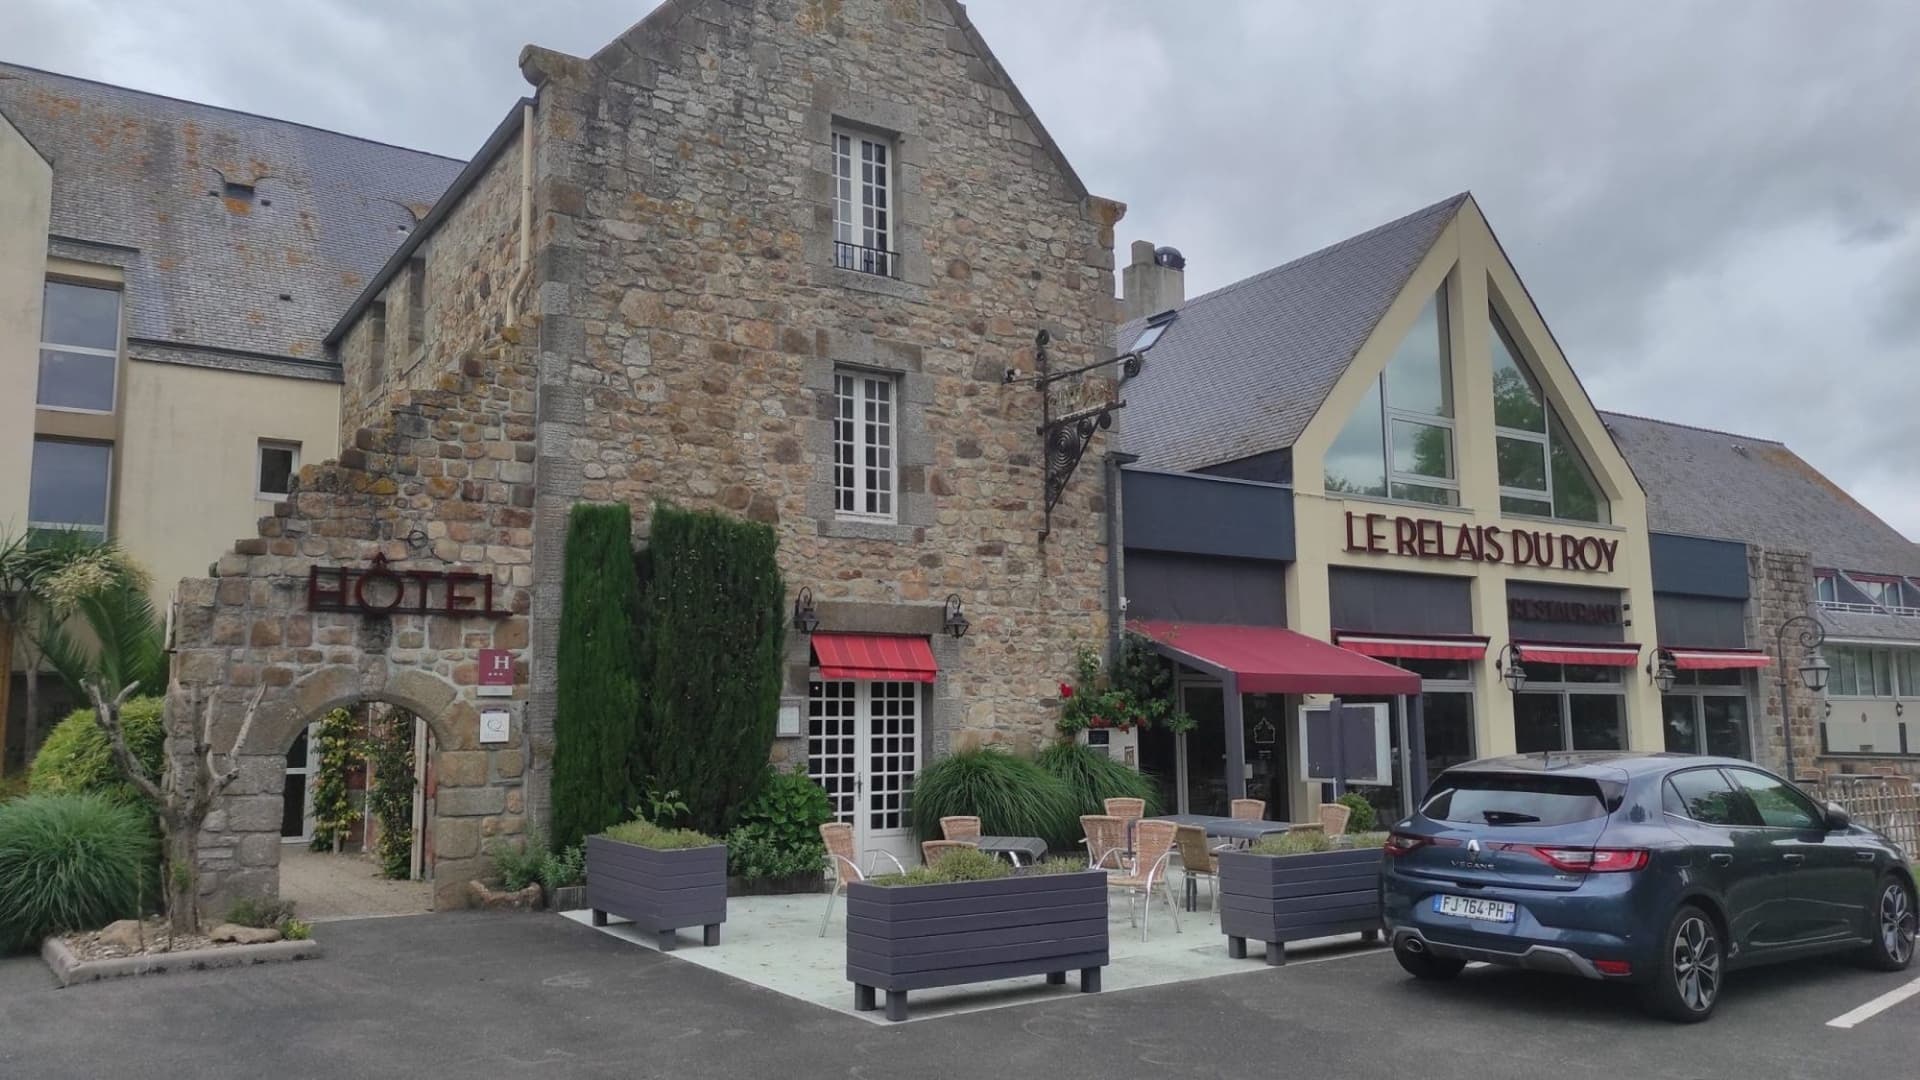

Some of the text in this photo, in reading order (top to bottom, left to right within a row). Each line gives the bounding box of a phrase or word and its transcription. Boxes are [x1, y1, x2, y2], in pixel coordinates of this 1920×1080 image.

[1345, 511, 1619, 573] LE RELAIS DU ROY
[1509, 598, 1618, 625] RESTAURANT
[494, 655, 510, 670] H
